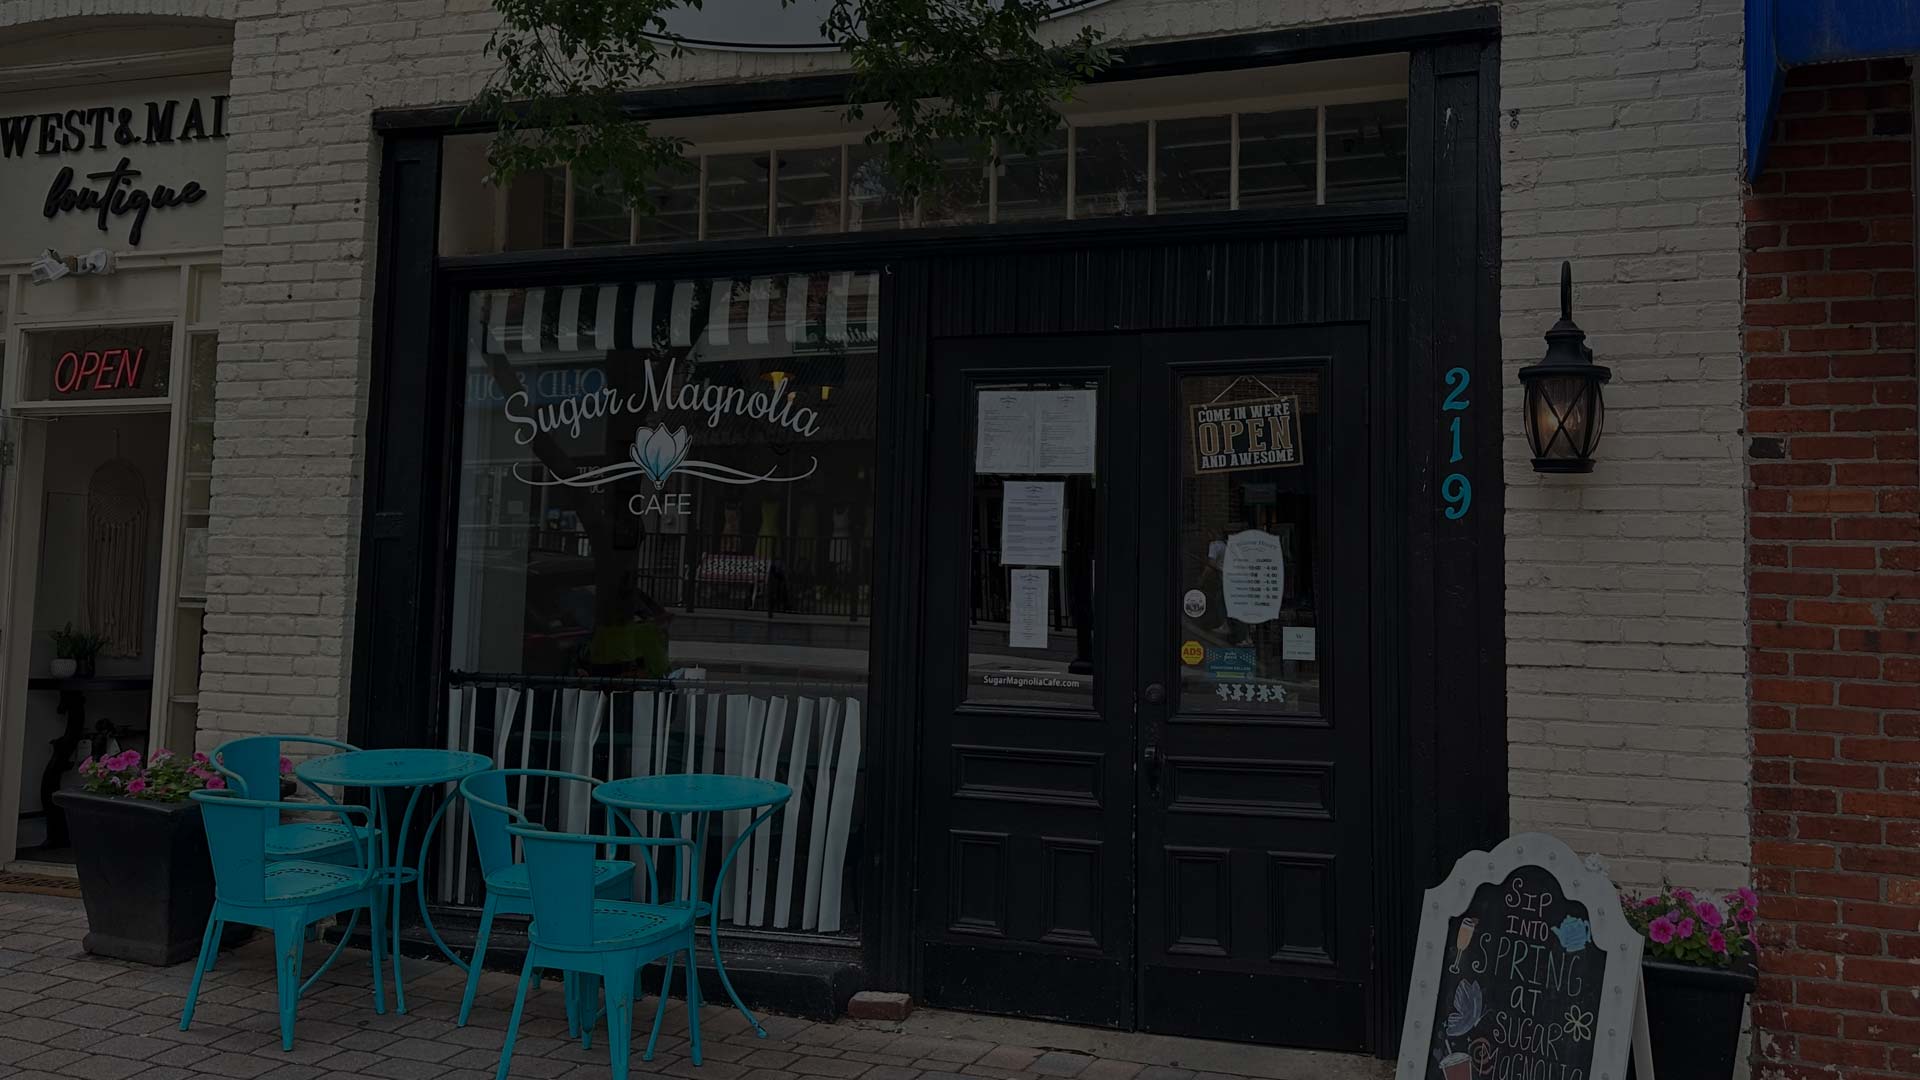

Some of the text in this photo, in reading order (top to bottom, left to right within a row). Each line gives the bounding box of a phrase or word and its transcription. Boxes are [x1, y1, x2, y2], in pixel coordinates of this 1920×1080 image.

[0, 95, 230, 158] WEST&MAI
[43, 157, 207, 245] boutique
[54, 346, 144, 393] OPEN
[504, 357, 820, 445] Sugar Magnolia
[1197, 408, 1231, 423] COME
[1234, 406, 1247, 420] IN
[1198, 416, 1293, 456] OPEN
[1201, 449, 1295, 469] AND AWESOME
[628, 493, 692, 516] CAFE
[983, 675, 1080, 688] SugarMagnoliaCafe.com
[1504, 877, 1553, 918] SIP
[1505, 915, 1549, 943] INTO
[1471, 932, 1584, 997] SPRING
